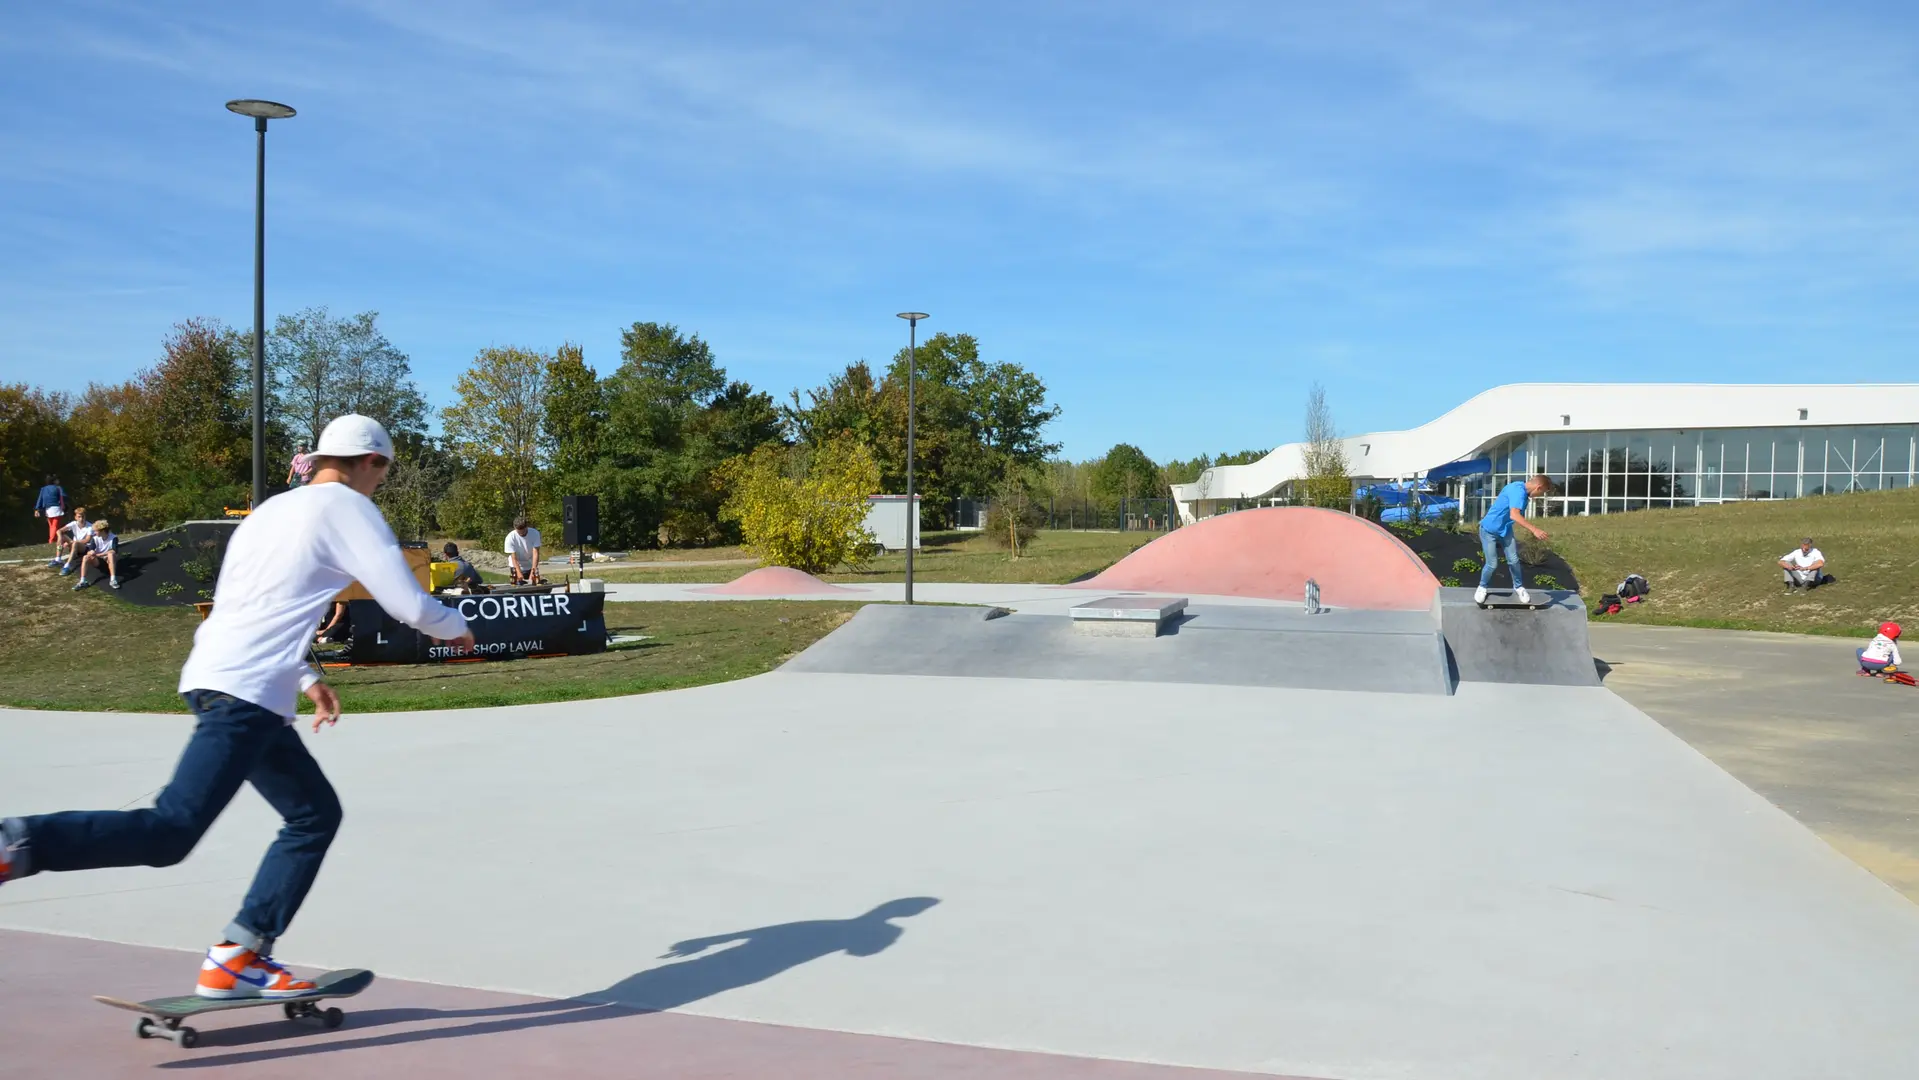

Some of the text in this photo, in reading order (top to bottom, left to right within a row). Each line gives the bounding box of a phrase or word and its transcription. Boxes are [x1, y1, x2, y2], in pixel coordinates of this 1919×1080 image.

[458, 595, 571, 621] CORNER
[473, 643, 506, 655] SHOP
[510, 640, 544, 653] LAVAL
